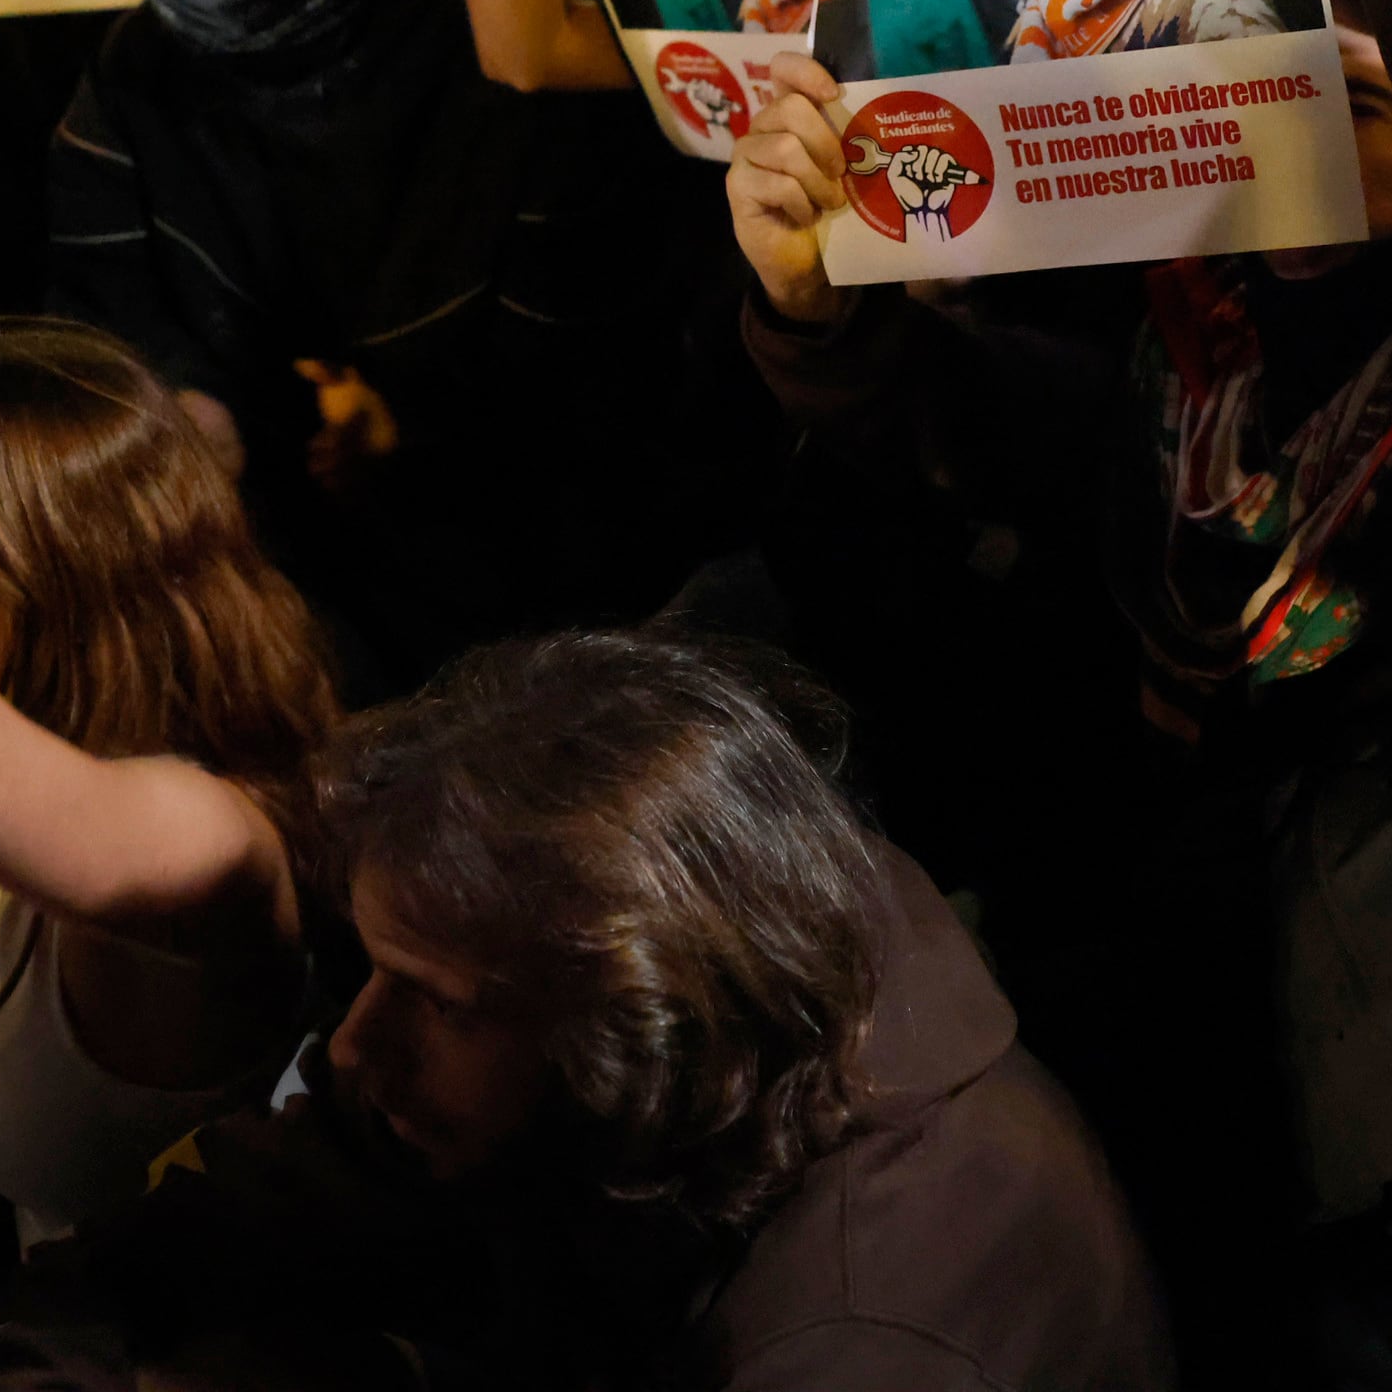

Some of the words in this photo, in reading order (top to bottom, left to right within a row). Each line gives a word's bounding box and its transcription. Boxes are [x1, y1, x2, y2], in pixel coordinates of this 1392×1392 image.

[874, 109, 935, 125] Sindicato
[936, 107, 953, 119] de
[999, 96, 1090, 132] Nunca
[1096, 94, 1125, 123] te
[1129, 73, 1322, 122] olvidaremos.
[879, 122, 955, 138] Estudiantes
[1006, 138, 1045, 168] Tu
[1049, 124, 1177, 166] memoria
[1182, 119, 1243, 150] vive
[1015, 175, 1052, 204] en
[1057, 163, 1168, 201] nuestra
[1174, 153, 1256, 188] lucha
